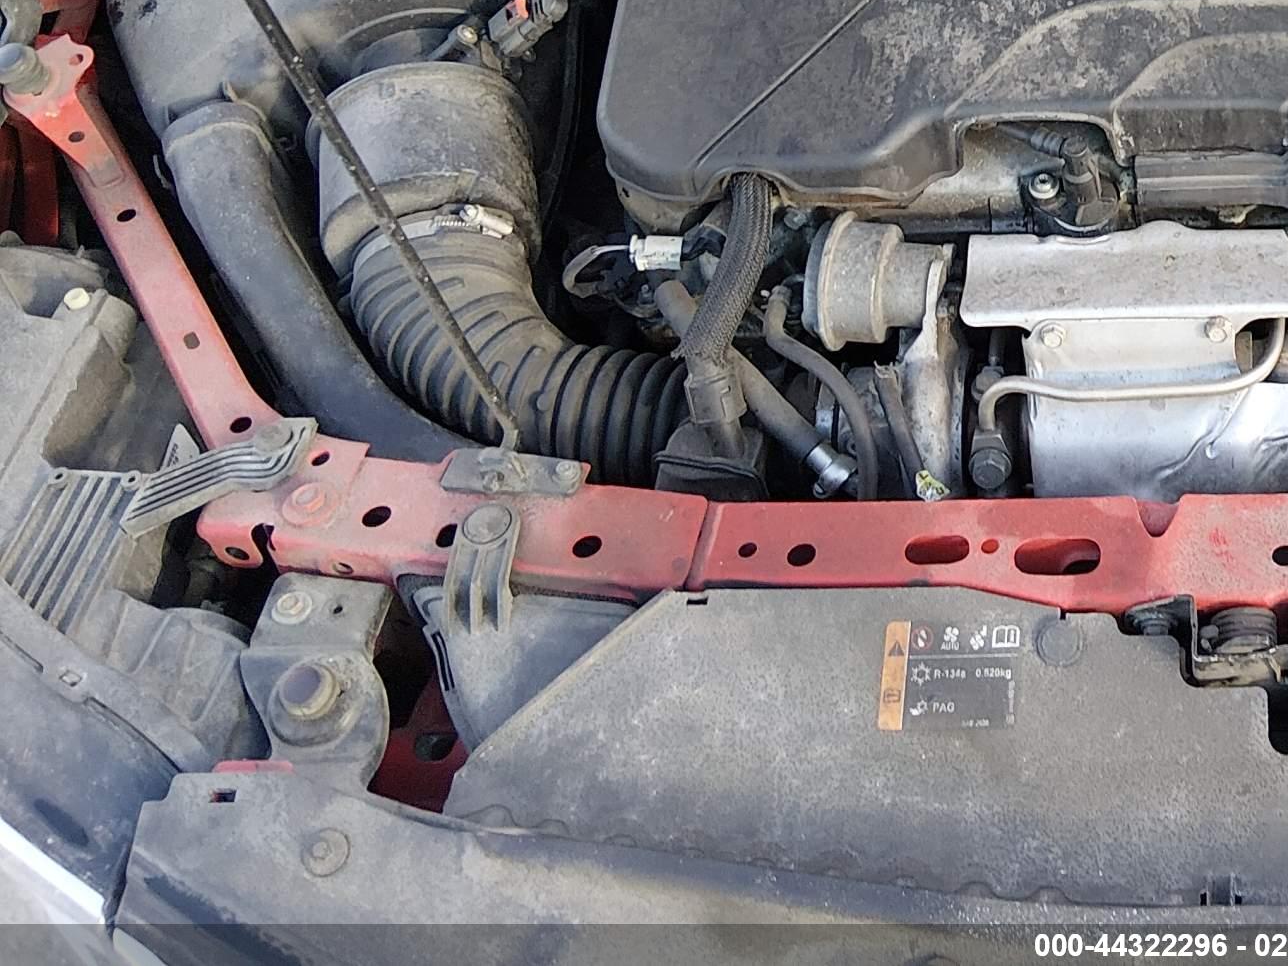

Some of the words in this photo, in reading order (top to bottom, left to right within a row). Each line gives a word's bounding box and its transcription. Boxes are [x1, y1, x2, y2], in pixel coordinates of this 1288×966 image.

[941, 642, 960, 650] AUTO
[934, 668, 966, 679] R-134a
[932, 702, 955, 713] PAG
